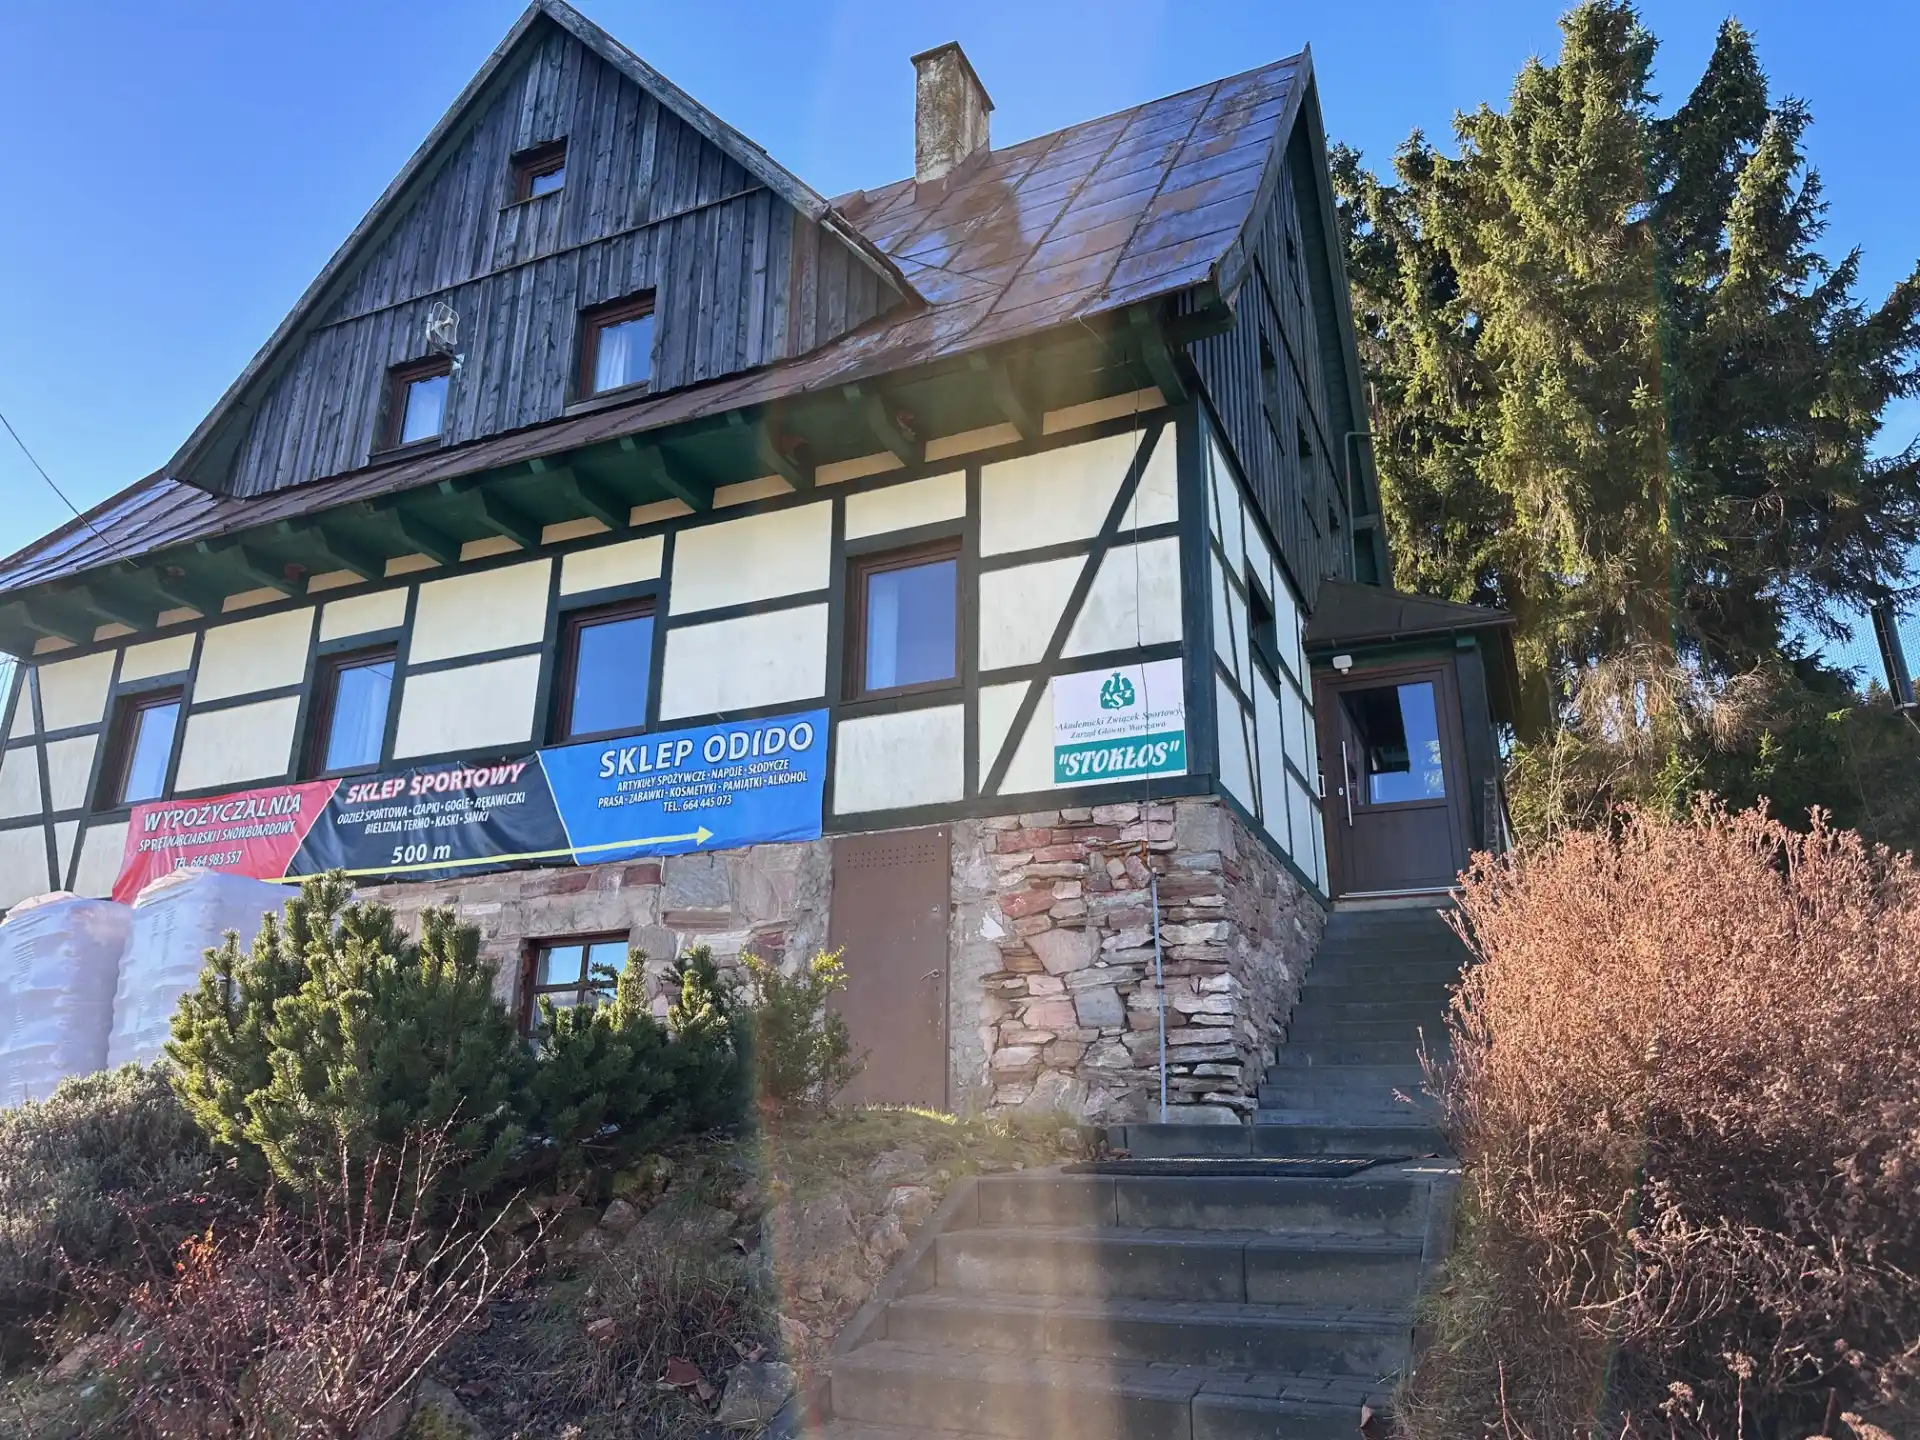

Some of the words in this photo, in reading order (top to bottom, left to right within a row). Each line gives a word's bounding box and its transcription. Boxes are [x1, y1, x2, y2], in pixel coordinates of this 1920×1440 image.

[1129, 720, 1166, 731] Warszawa
[599, 739, 694, 778] SKLEP
[703, 722, 814, 763] ODIDO
[1058, 740, 1180, 776] "STOKŁOS"
[345, 778, 405, 804] SKLEP
[409, 763, 527, 796] SPORTOWY
[598, 795, 624, 808] PRASA
[628, 789, 665, 804] ZABAWKI
[669, 781, 717, 798] KOSMETYKI
[722, 777, 763, 793] PAMIĄTKI
[767, 770, 808, 786] ALKOHOL
[617, 776, 657, 792] ARTYKUŁY
[657, 770, 706, 786] SPOŻYWCZE
[711, 765, 743, 781] NAPOJE
[748, 759, 790, 775] SŁODYCZE
[143, 793, 302, 832] WYPOŻYCZALNIA
[337, 808, 366, 824] ODZIEŻ
[364, 806, 407, 821] SPORTOWA
[413, 802, 440, 815] CZAPKI
[445, 797, 471, 811] GOGLE
[474, 791, 526, 811] RĘKAWICZKI
[663, 801, 681, 812] TEL.
[683, 799, 699, 811] 664
[699, 797, 716, 809] 445
[716, 794, 732, 807] 073
[168, 830, 215, 848] NARCIARSKI
[223, 820, 296, 841] SNOWBOARDOWY
[364, 820, 401, 834] BIELIZNA
[404, 817, 430, 831] TERMO
[435, 814, 459, 827] KASKI
[463, 811, 490, 824] SANKI
[191, 855, 208, 867] 664
[208, 852, 225, 866] 983
[225, 850, 242, 864] 557
[391, 843, 427, 864] 500
[432, 844, 451, 860] m
